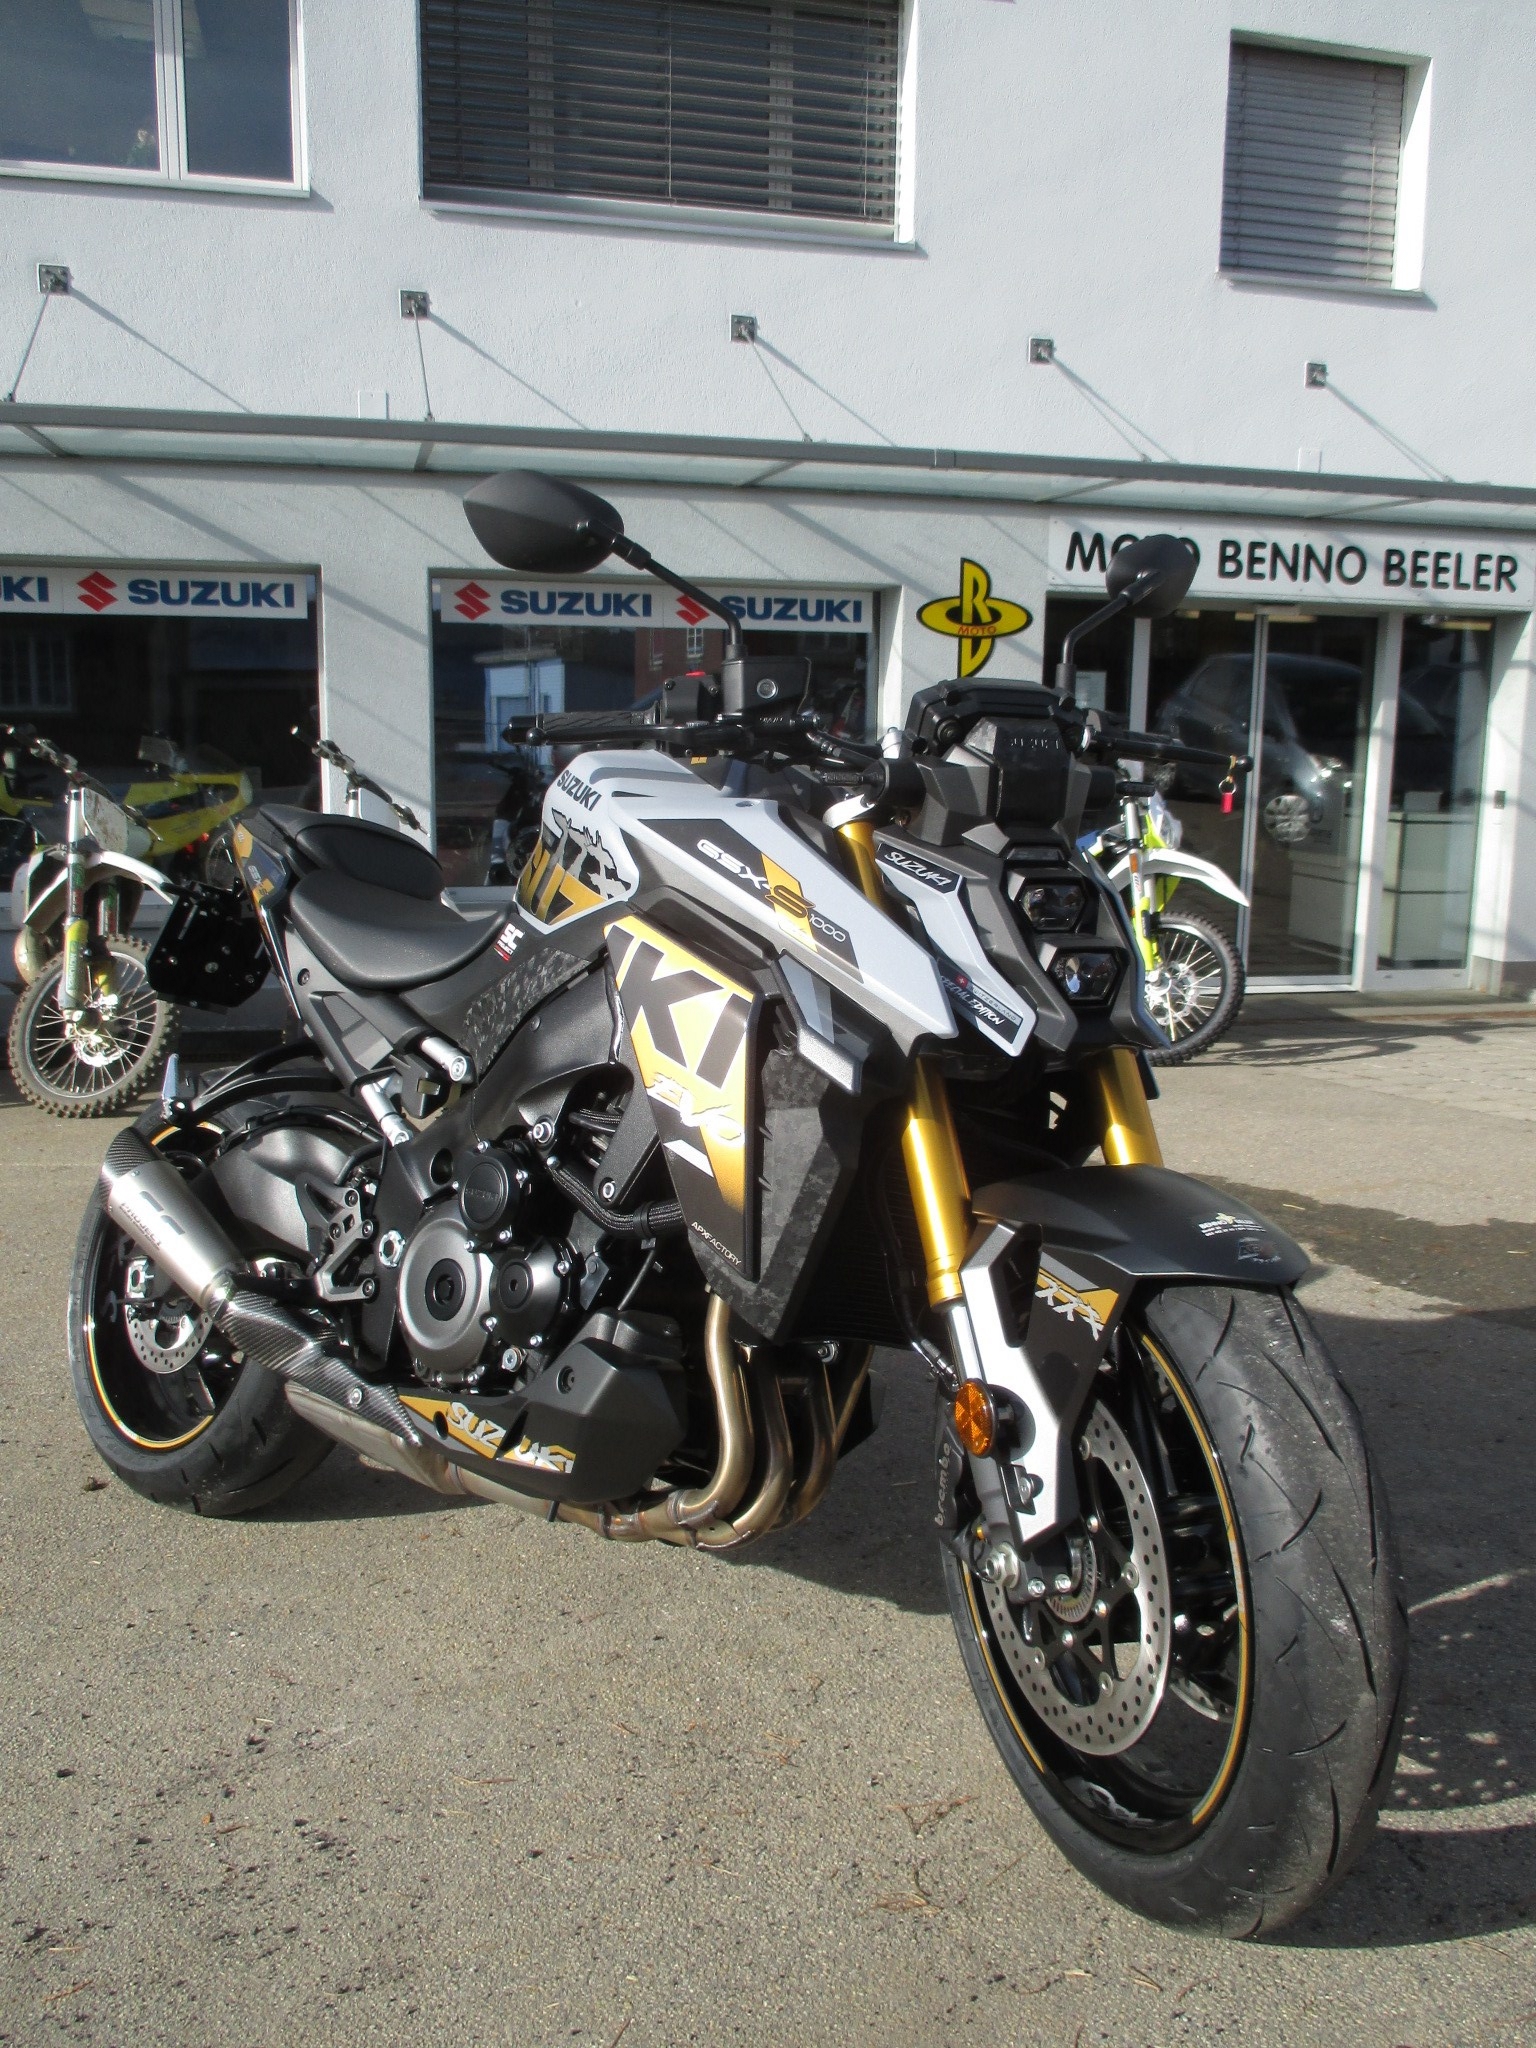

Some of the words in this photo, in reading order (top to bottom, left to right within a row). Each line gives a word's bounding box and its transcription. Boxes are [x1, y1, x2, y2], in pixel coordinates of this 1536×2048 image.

[1218, 540, 1367, 585] BENNO
[1383, 548, 1518, 593] BEELER
[0, 576, 49, 602] KI
[127, 579, 295, 608] SUZUKI
[500, 589, 652, 617] SUZUKI
[719, 595, 862, 623] SUZUKI
[957, 625, 997, 635] MOTO
[556, 769, 602, 811] SUZUKI
[884, 851, 952, 887] SUZUKI
[809, 913, 846, 942] 1000
